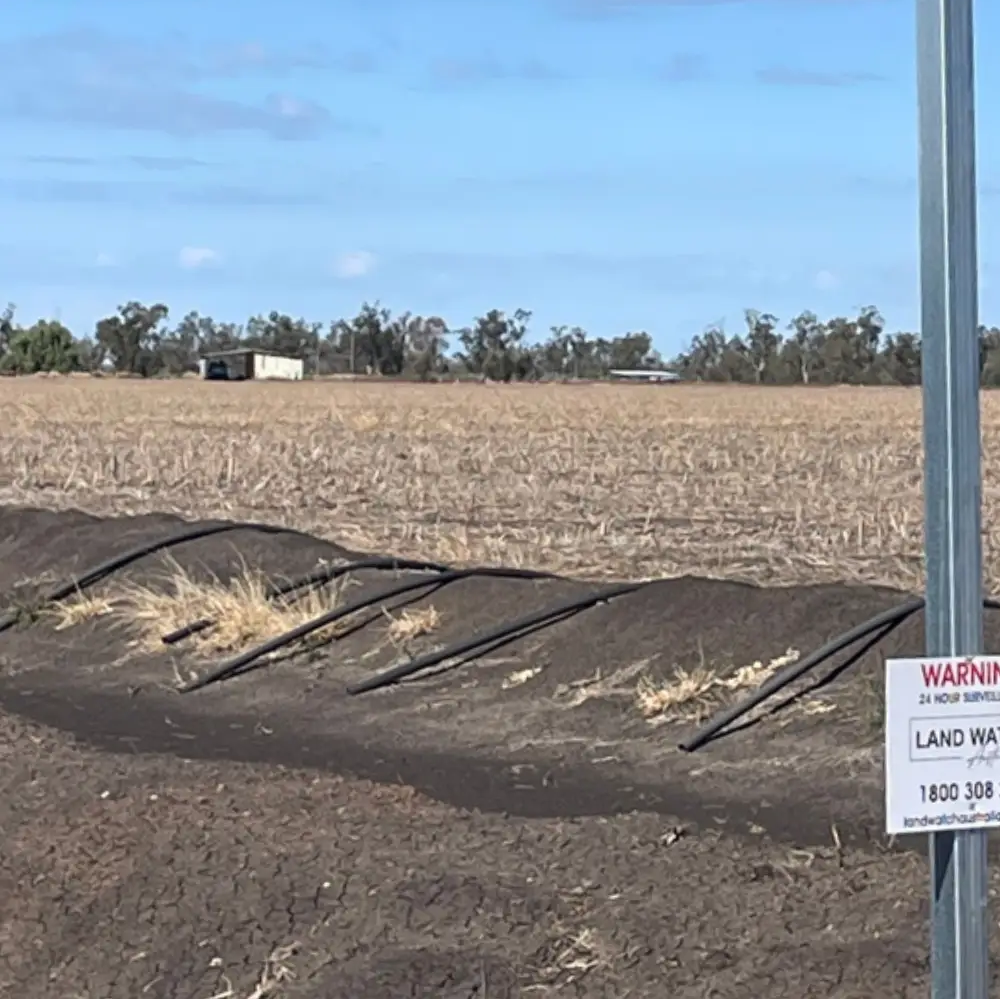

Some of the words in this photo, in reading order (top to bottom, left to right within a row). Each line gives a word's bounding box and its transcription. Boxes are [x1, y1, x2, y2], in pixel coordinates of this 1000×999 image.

[919, 693, 931, 705] 24
[934, 691, 960, 704] HOUR
[916, 729, 964, 749] LAND
[920, 782, 959, 803] 1800
[964, 781, 994, 800] 308
